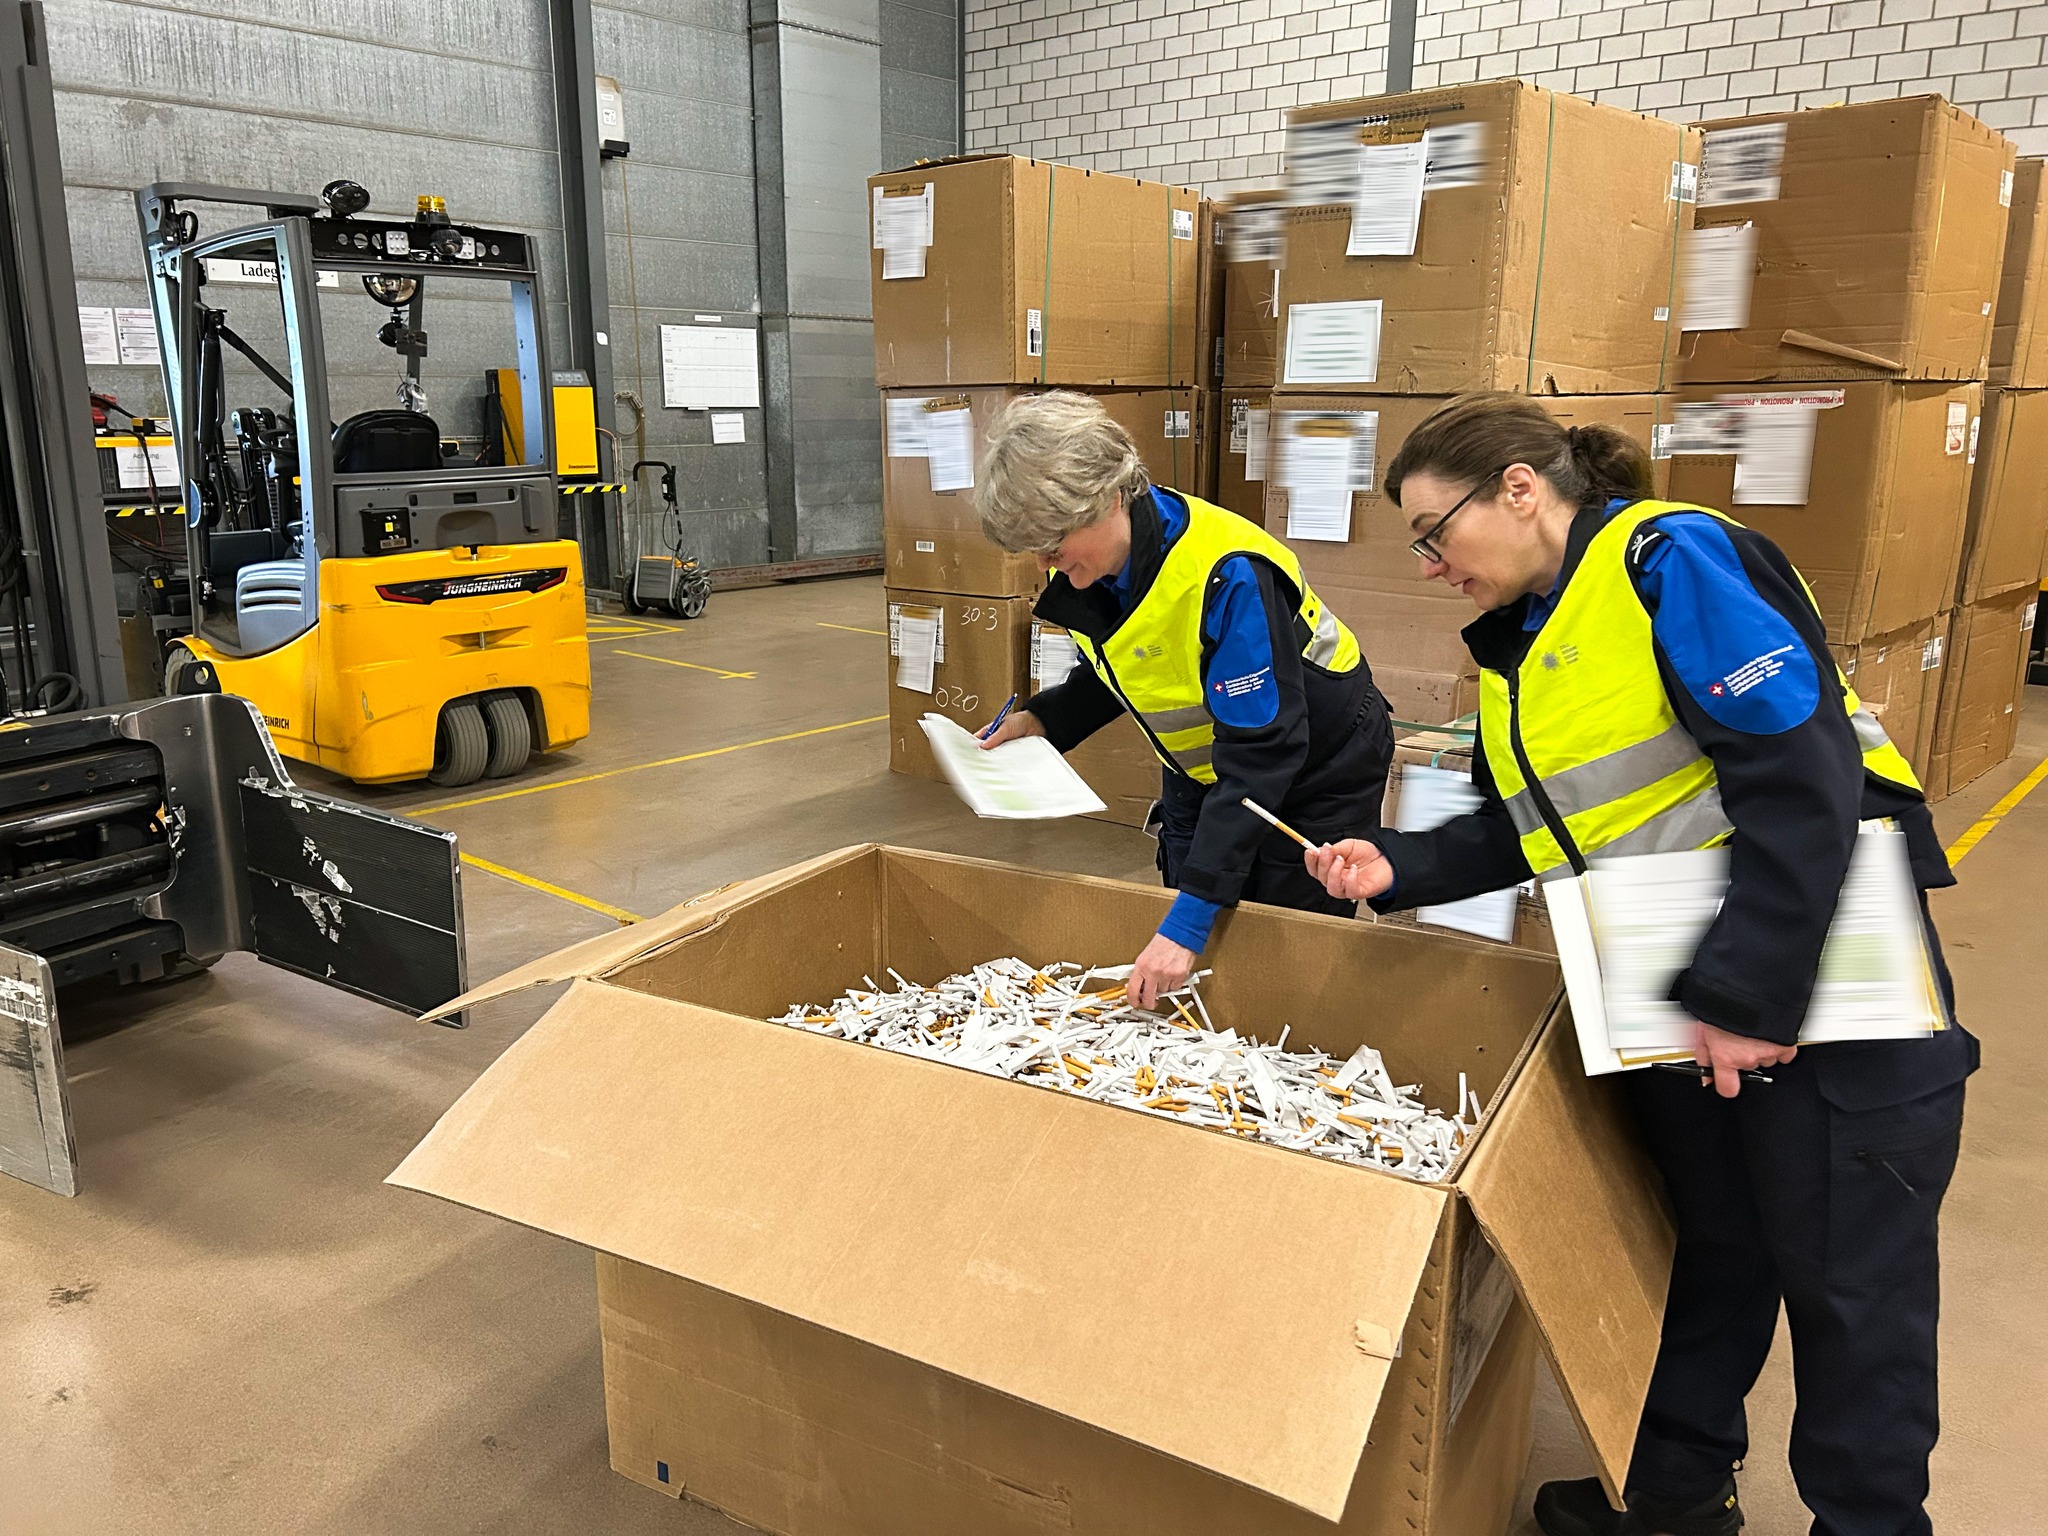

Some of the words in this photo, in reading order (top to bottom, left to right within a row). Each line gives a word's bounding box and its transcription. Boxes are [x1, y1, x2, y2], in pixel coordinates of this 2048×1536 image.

[241, 263, 278, 282] Ladeg
[1760, 397, 1794, 406] PROMOTION
[1799, 396, 1834, 405] PROMOTION
[443, 578, 522, 595] JUNGHEINRICH
[263, 715, 290, 729] EINRICH
